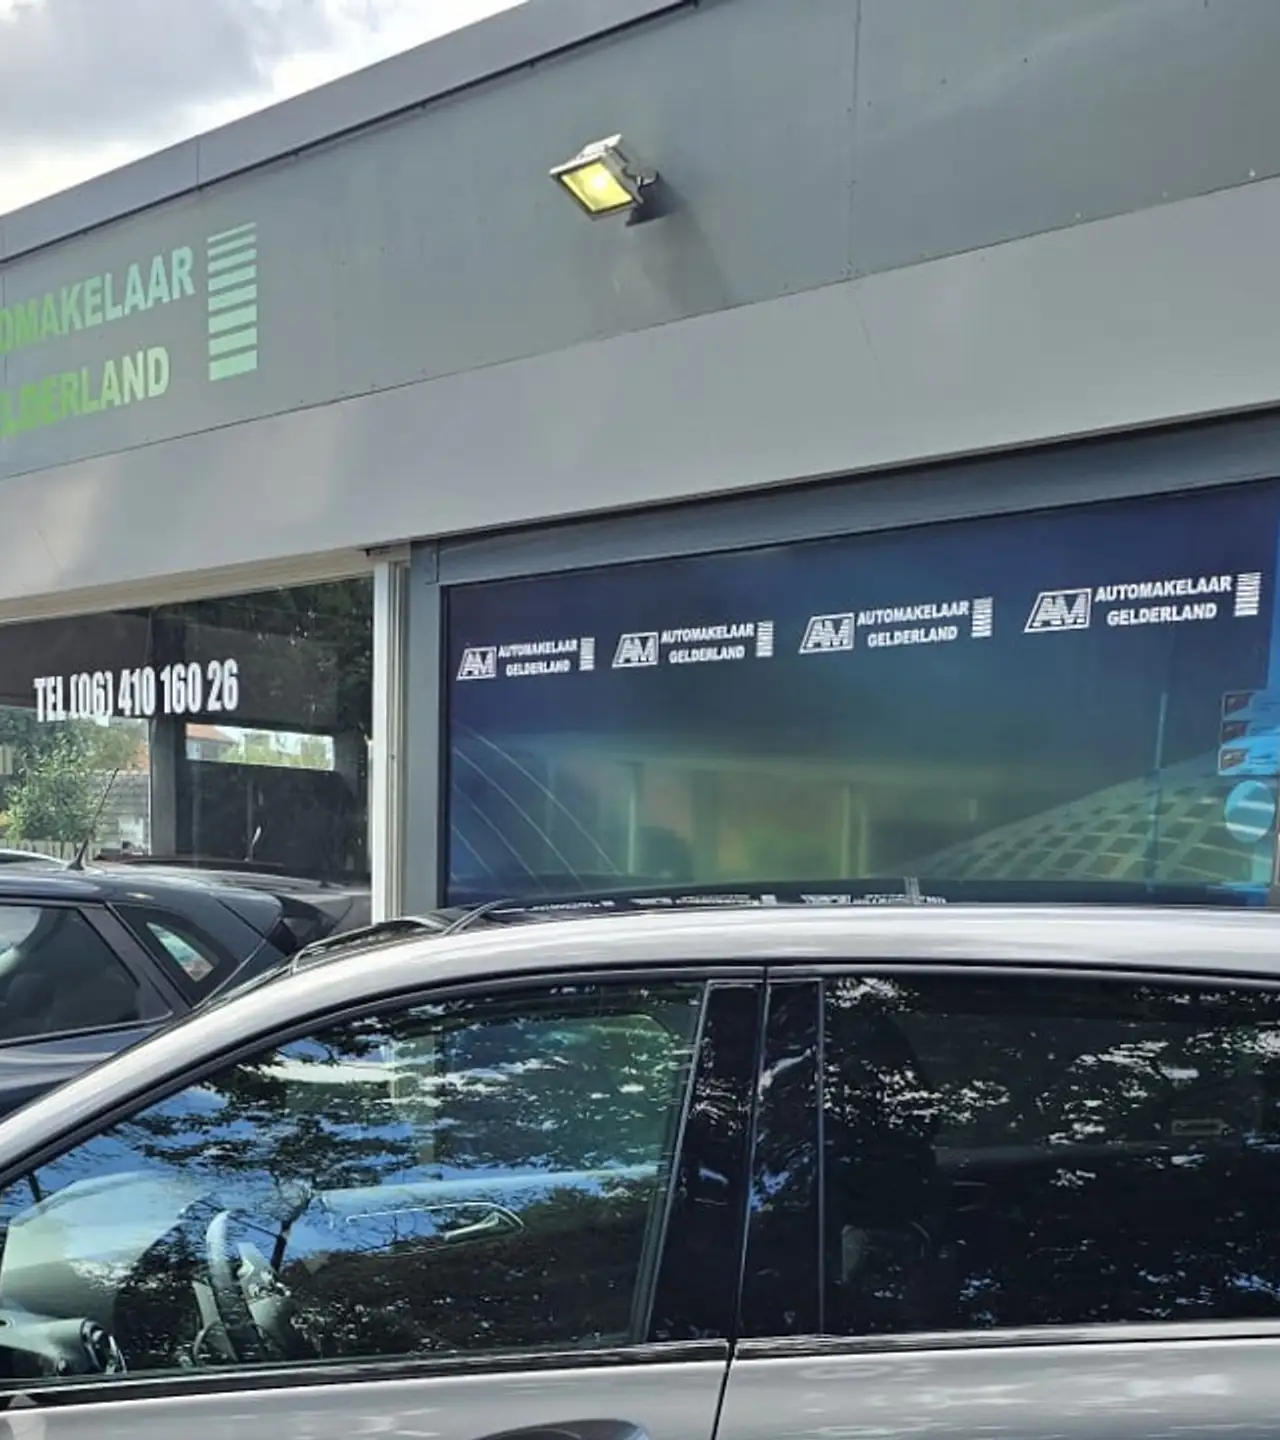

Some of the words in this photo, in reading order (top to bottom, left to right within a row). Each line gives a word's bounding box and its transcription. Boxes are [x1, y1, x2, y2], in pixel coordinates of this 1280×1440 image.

[1094, 575, 1232, 603] AUTOMAKELAAR
[856, 600, 970, 627] AUTOMAKELAAR
[1030, 592, 1088, 629] AM
[1106, 602, 1218, 627] GELDERLAND
[660, 623, 755, 645] AUTOMAKELAAR
[804, 617, 853, 650] AM
[867, 625, 958, 648] GELDERLAND
[498, 639, 579, 658] AUTOMAKELAAR
[669, 645, 746, 664] GELDERLAND
[506, 660, 571, 678] GELDERLAND
[33, 675, 67, 723] TEL
[118, 665, 156, 717] 410
[160, 661, 203, 714] 160
[206, 657, 240, 713] 26
